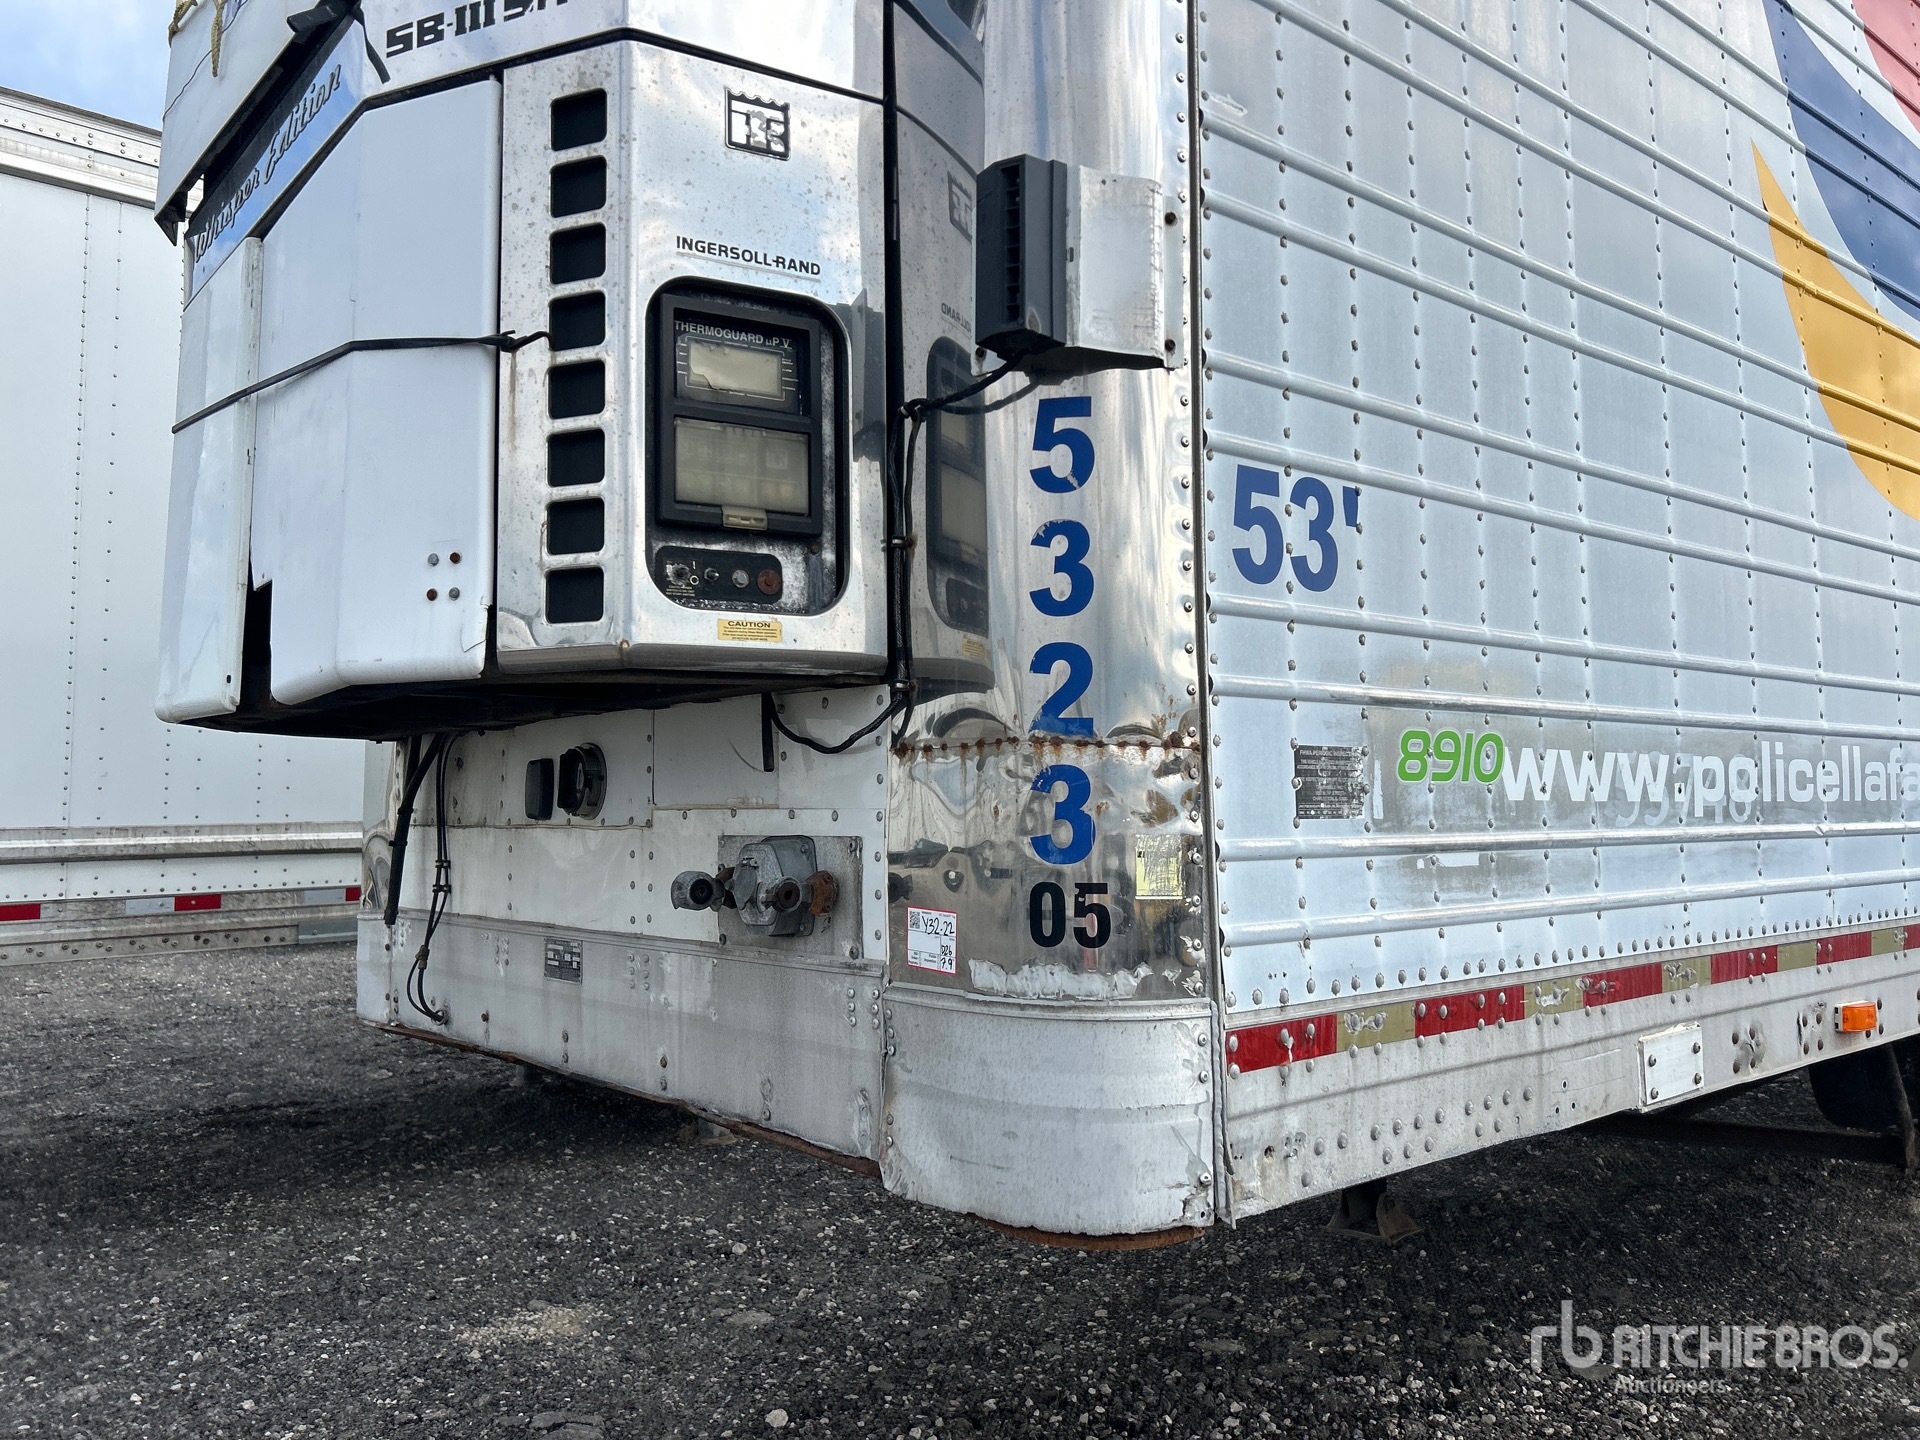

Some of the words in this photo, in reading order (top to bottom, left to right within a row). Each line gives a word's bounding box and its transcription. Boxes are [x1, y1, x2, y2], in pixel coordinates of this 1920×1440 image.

[264, 64, 342, 184] Edition
[676, 236, 821, 276] INGERSOLL-RAND
[674, 320, 764, 344] THERMOGUARD
[727, 620, 771, 628] CAUTION
[1398, 729, 1503, 784] 8910
[1029, 881, 1112, 949] 05
